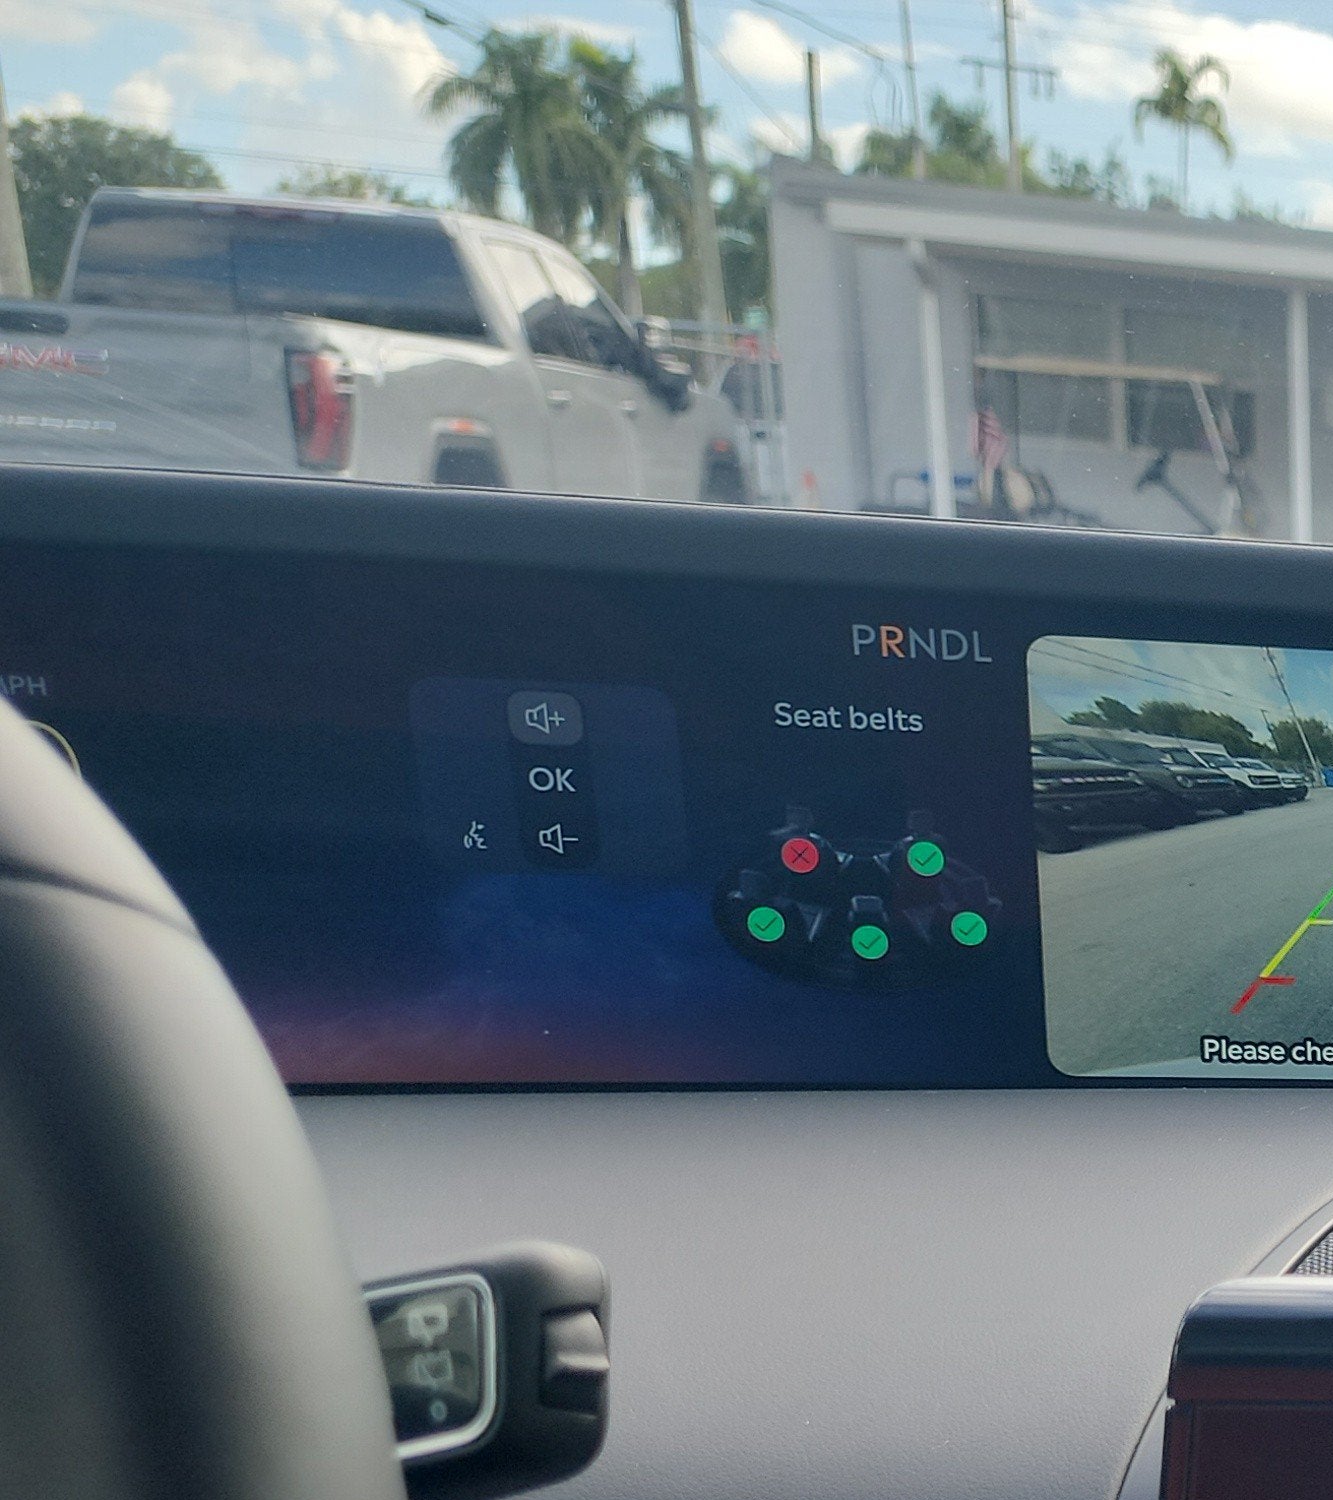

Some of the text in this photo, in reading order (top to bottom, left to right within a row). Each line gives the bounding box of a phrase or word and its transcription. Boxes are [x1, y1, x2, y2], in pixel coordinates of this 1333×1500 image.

[0, 343, 109, 378] MC
[851, 623, 993, 664] PRNDL
[773, 702, 925, 733] Seat belts
[528, 766, 577, 793] OK
[1202, 1038, 1286, 1062] Please
